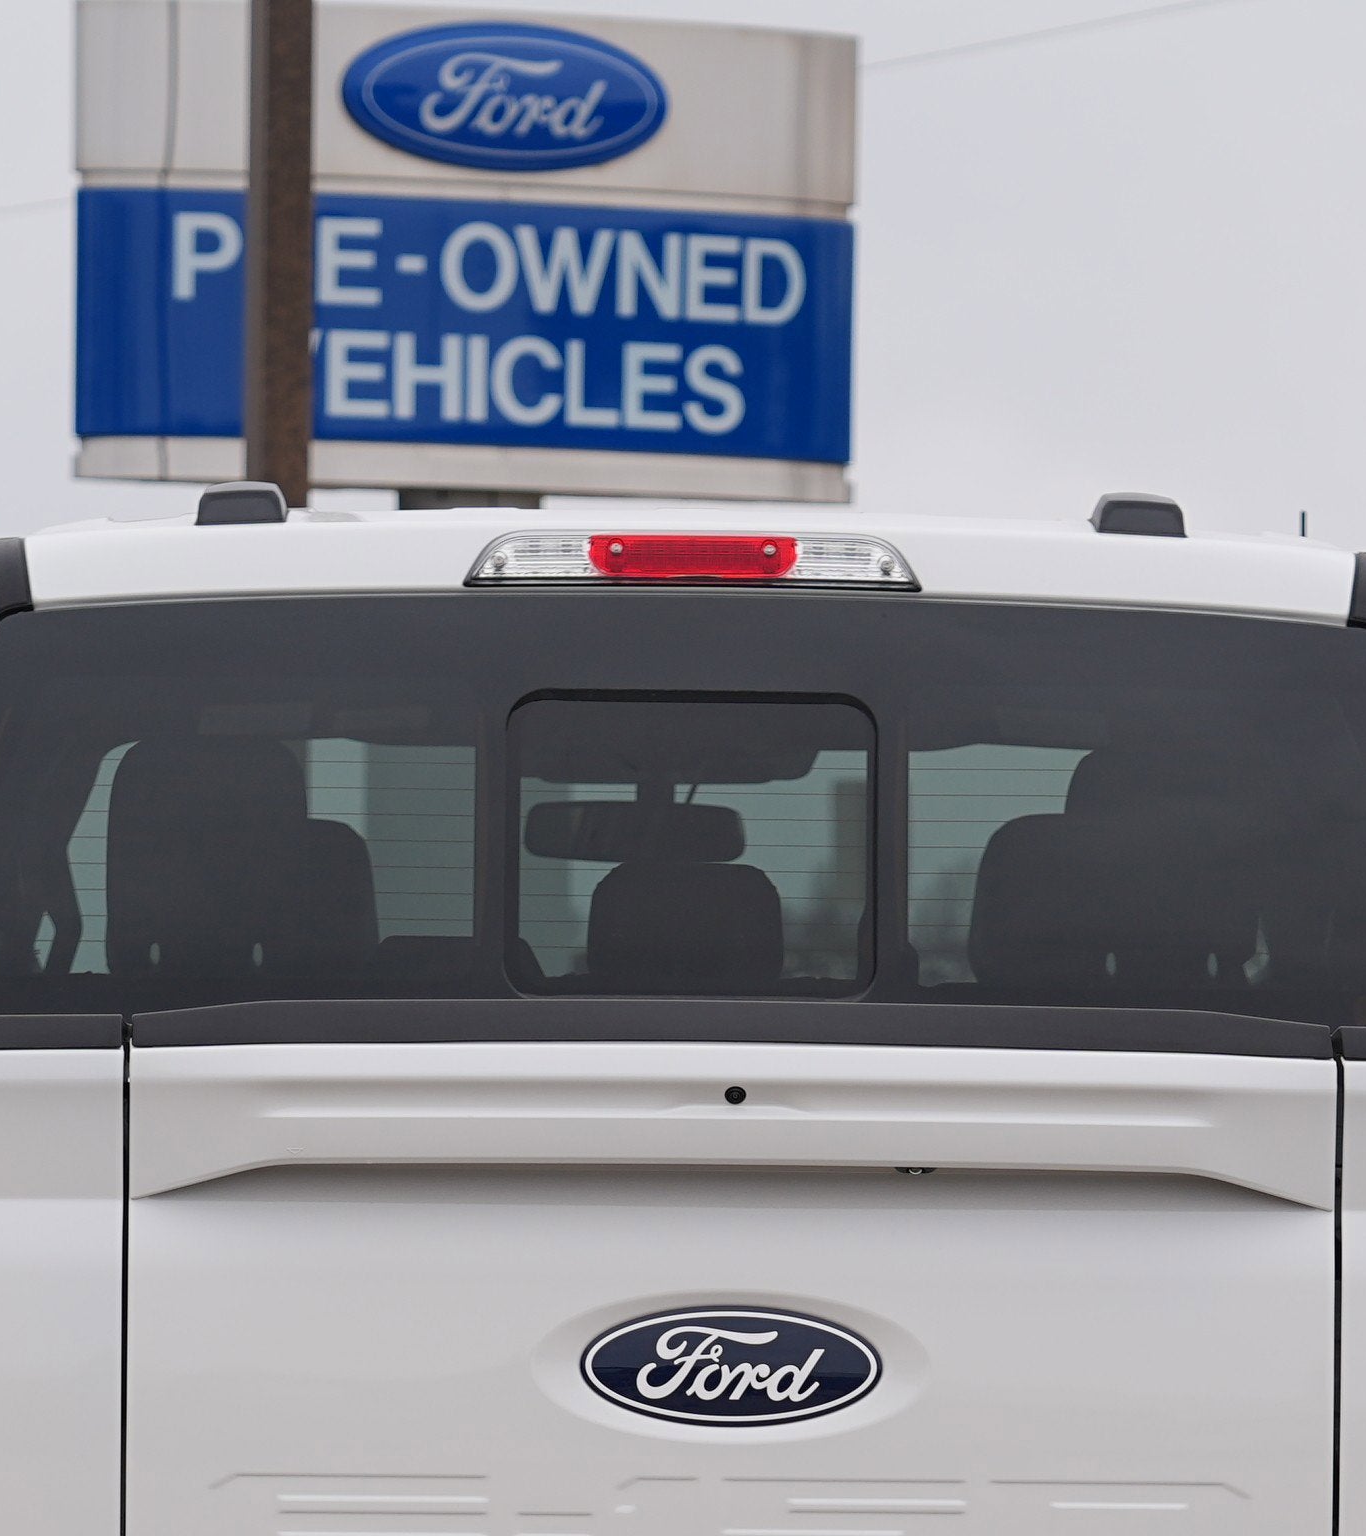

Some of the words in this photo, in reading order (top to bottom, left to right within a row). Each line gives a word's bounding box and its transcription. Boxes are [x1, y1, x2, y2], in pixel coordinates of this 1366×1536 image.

[418, 51, 606, 142] Ford
[171, 211, 807, 328] PE-OWNED
[309, 329, 746, 436] EHICLES
[636, 1325, 825, 1402] Ford
